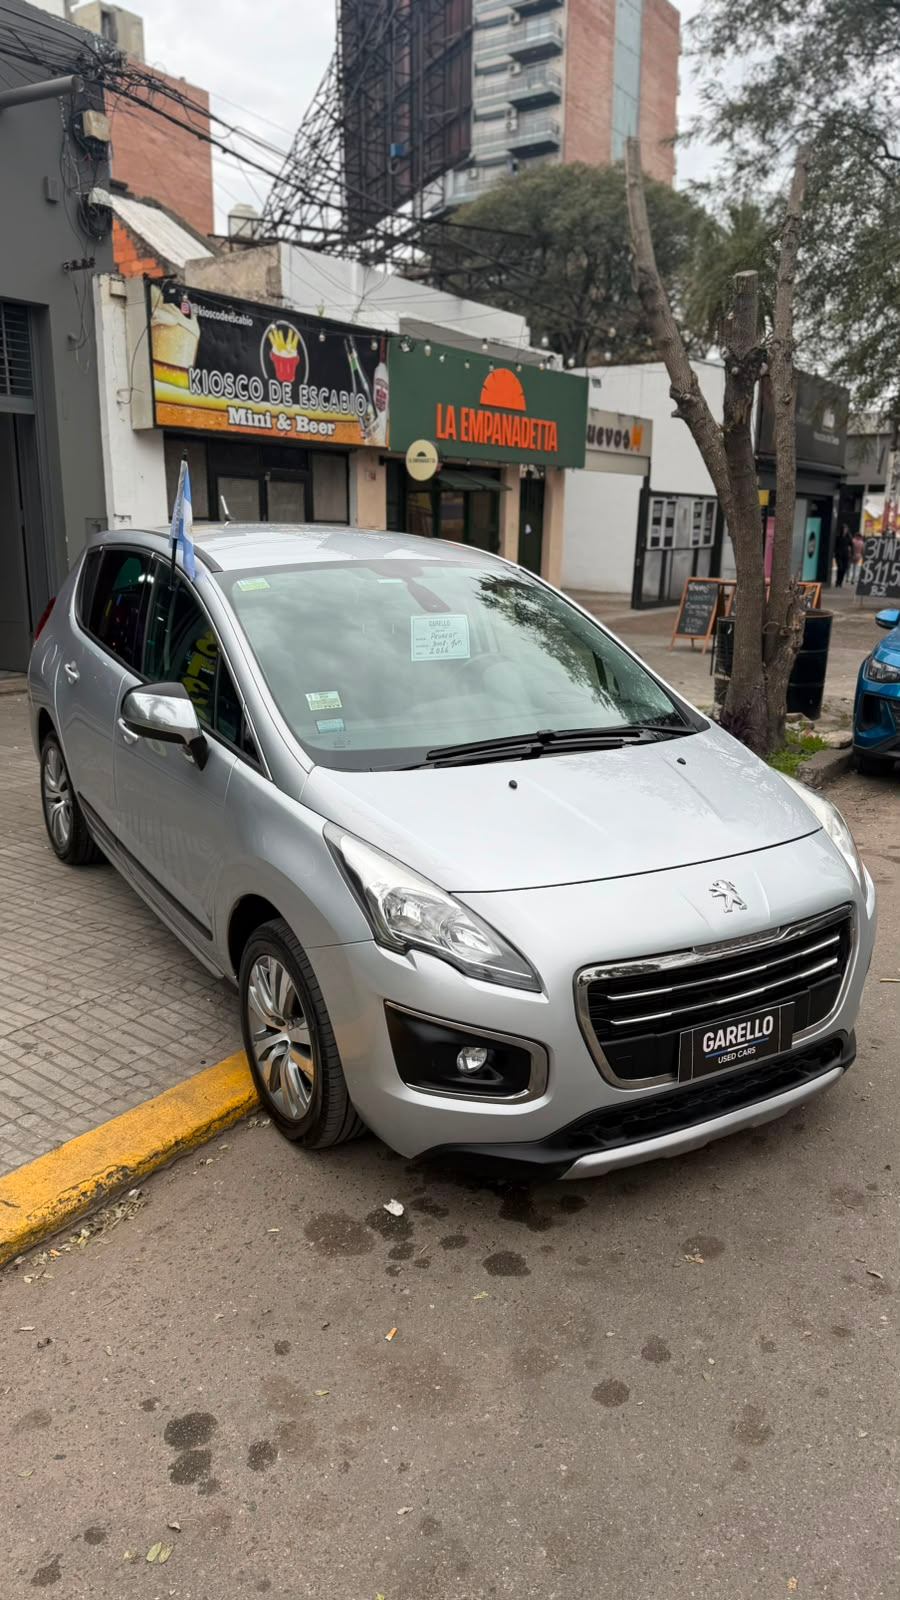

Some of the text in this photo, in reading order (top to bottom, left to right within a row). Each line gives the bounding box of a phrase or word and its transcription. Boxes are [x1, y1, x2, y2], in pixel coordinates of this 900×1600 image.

[188, 367, 264, 401] KIOSCO
[268, 379, 293, 406] DE
[299, 384, 368, 416] ESCABIO
[228, 406, 336, 436] Mini & Beer
[436, 403, 558, 452] LA EMPANADETTA
[702, 1015, 774, 1053] GARELLO
[718, 1046, 757, 1064] USED CARS
